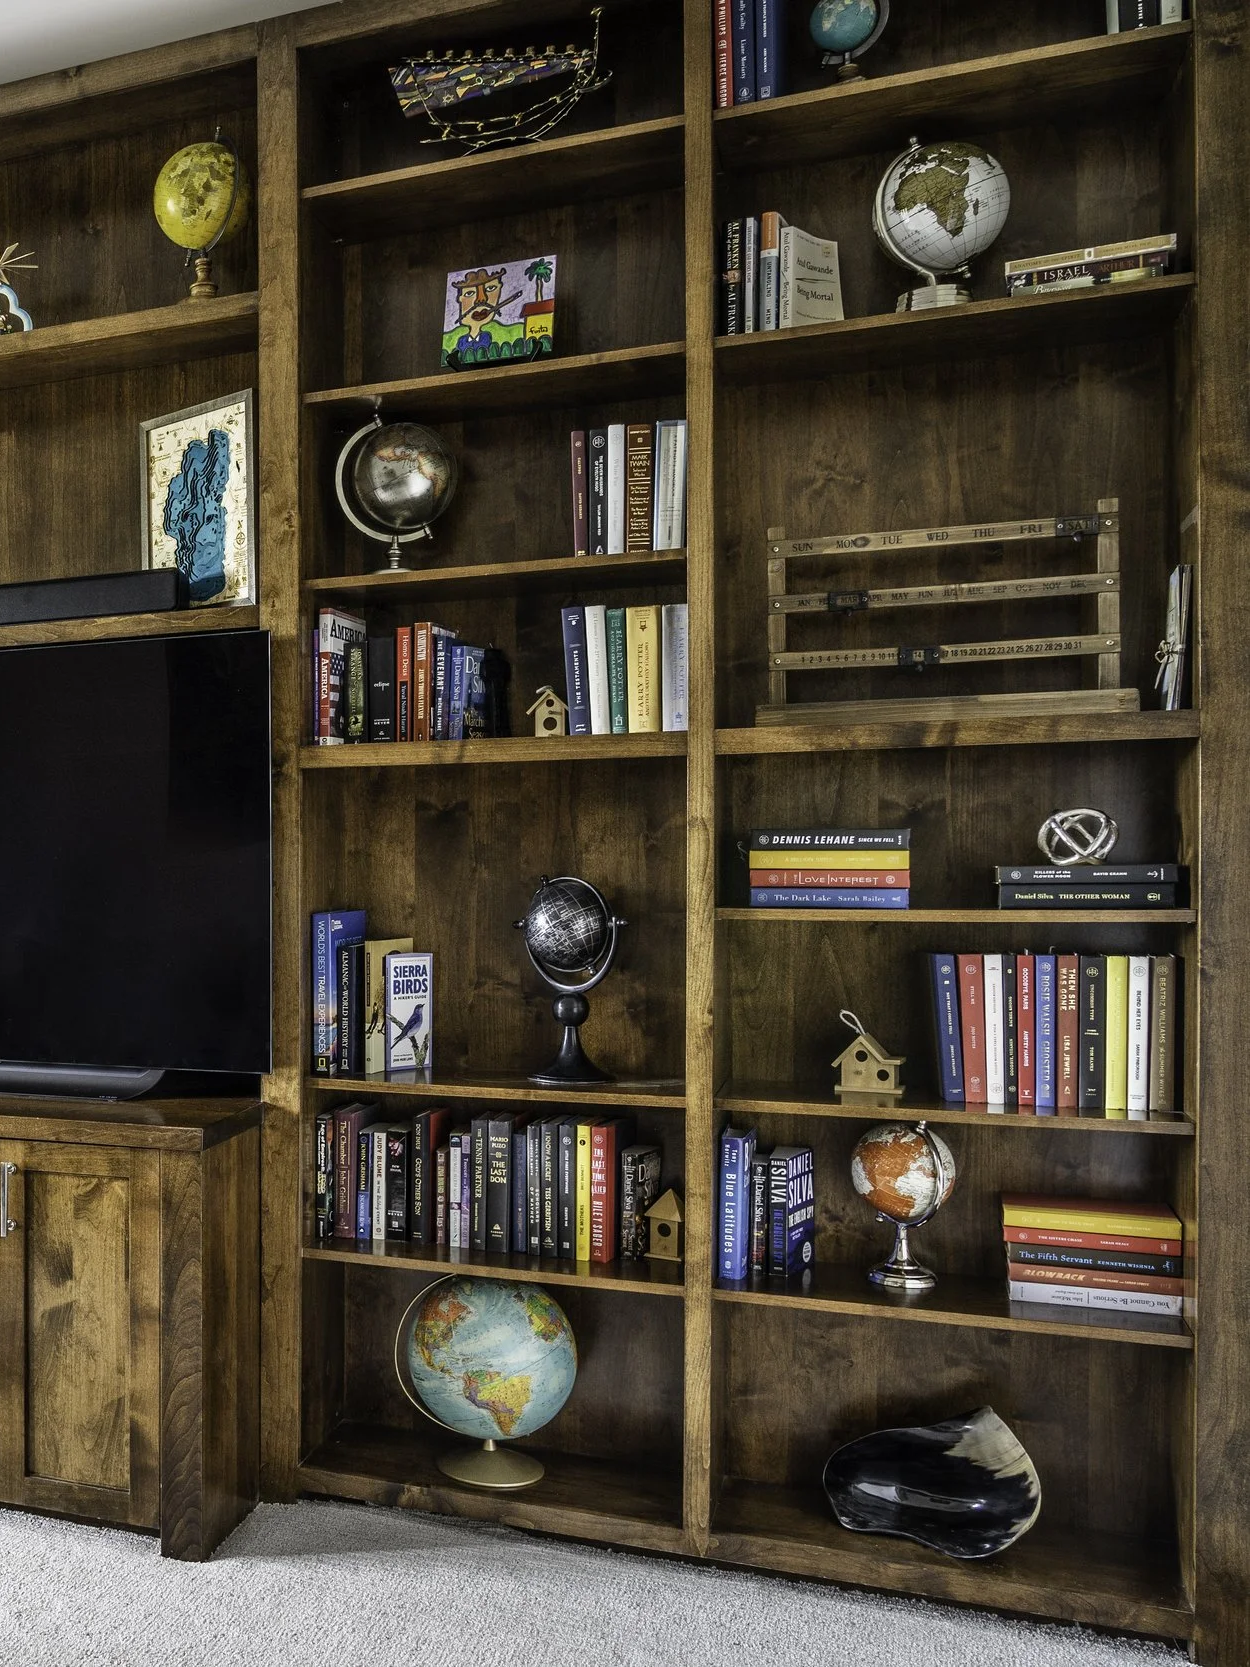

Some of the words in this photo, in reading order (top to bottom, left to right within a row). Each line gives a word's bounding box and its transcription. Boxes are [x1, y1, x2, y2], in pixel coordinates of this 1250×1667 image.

[718, 7, 726, 35] PHILLIPS
[732, 222, 739, 232] AL
[806, 261, 833, 275] Gawande
[1044, 266, 1090, 280] ISRAEL
[728, 292, 735, 303] AL
[810, 291, 833, 301] Mortal
[792, 543, 813, 552] SUN
[836, 540, 856, 549] MON
[881, 535, 902, 545] TUE
[926, 532, 949, 541] WED
[972, 528, 995, 537] THU
[1020, 524, 1043, 533] FRI
[1067, 520, 1089, 531] SAT
[417, 630, 426, 661] WASHINGTON
[321, 658, 329, 699] AMERICA
[437, 652, 445, 690] REVENANT
[573, 651, 581, 690] TESTAMENTS
[374, 681, 390, 691] eclipse
[453, 686, 461, 700] Silva
[772, 835, 811, 844] DENNIS
[814, 835, 855, 844] LEHANE
[317, 956, 325, 974] BEST
[393, 964, 428, 978] SIERRA
[393, 978, 428, 995] BIRDS
[1041, 975, 1049, 1002] ROSIE
[1068, 968, 1076, 992] THEN
[318, 976, 326, 1003] TRAVEL
[1068, 994, 1076, 1010] SHE
[318, 1004, 326, 1053] EXPERIENCES
[1040, 1004, 1050, 1035] WALSH
[1041, 1041, 1050, 1081] GHOSTED
[492, 1160, 506, 1169] THE
[789, 1152, 813, 1179] DANIEL
[490, 1176, 506, 1184] DON
[725, 1173, 736, 1196] Blue
[771, 1168, 786, 1203] SILVA
[756, 1185, 764, 1206] Daniel
[789, 1173, 813, 1209] SILVA
[593, 1201, 603, 1221] RILEY
[625, 1196, 633, 1210] Silva
[755, 1207, 764, 1222] Silva
[774, 1209, 783, 1220] THE
[593, 1224, 602, 1246] SAGER
[724, 1202, 735, 1253] Latitudes
[774, 1222, 783, 1248] ENGLISH
[1019, 1250, 1035, 1259] The
[1038, 1252, 1058, 1261] Fifth
[1061, 1254, 1093, 1264] Servant
[1023, 1269, 1085, 1281] BLOWBACK
[1093, 1296, 1117, 1304] Serious
[1130, 1299, 1155, 1308] Cannot
[1156, 1301, 1170, 1309] You
